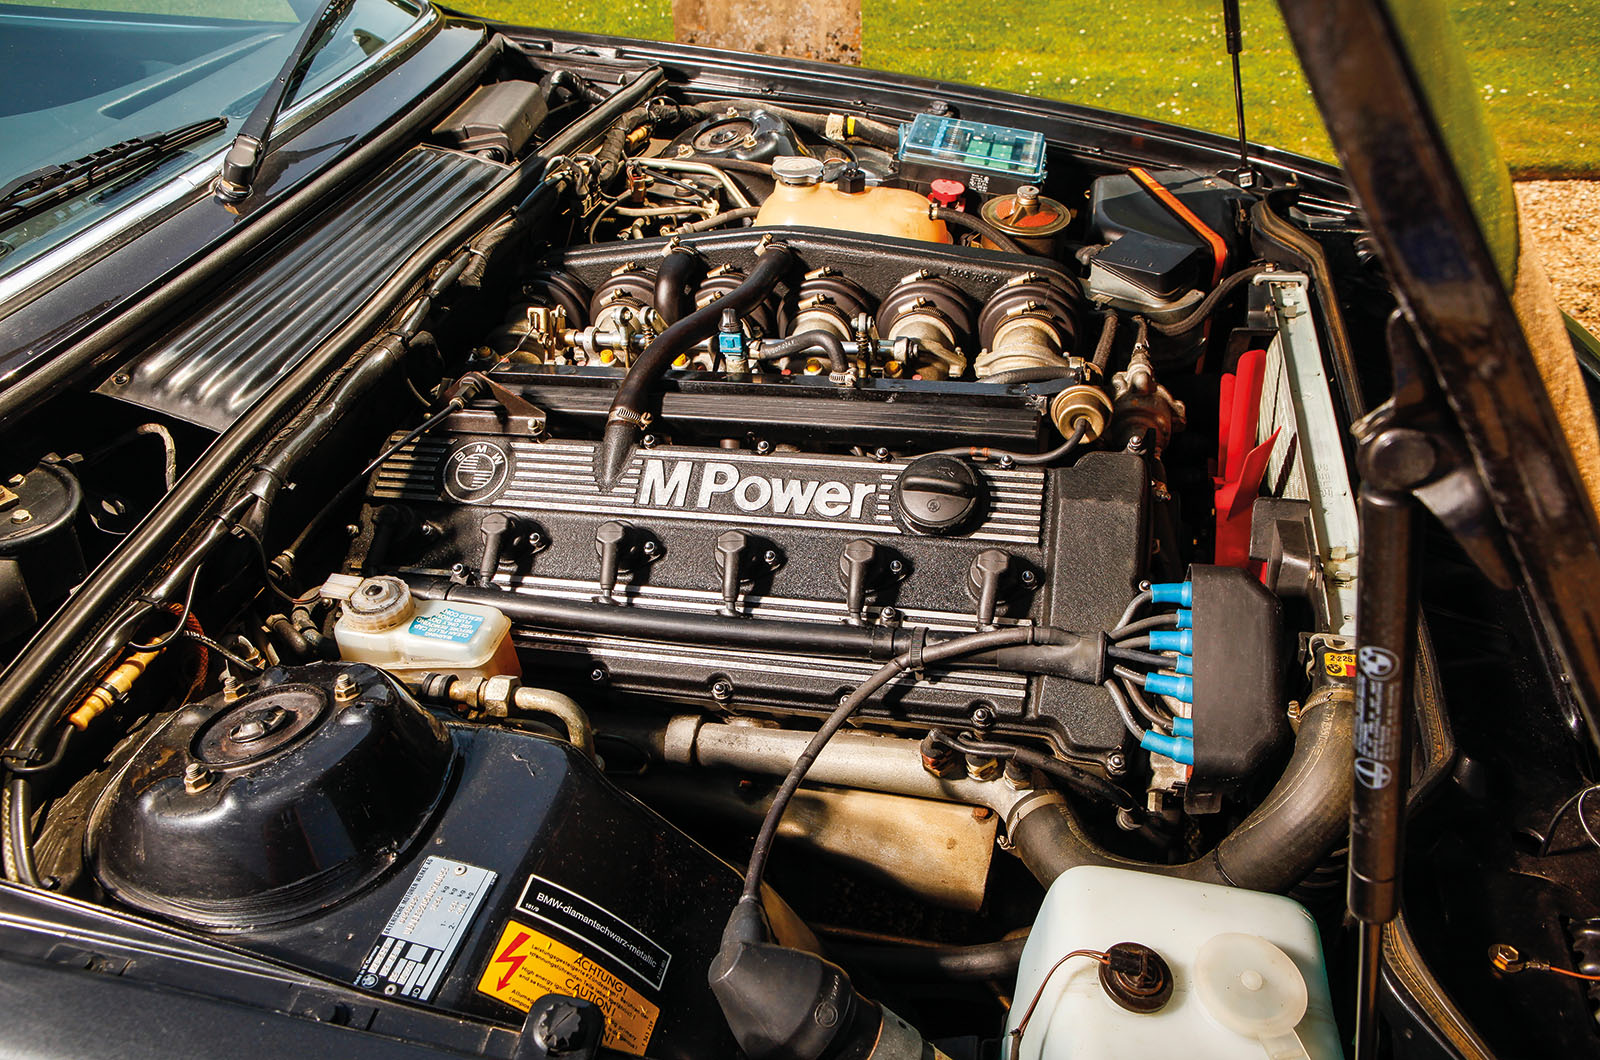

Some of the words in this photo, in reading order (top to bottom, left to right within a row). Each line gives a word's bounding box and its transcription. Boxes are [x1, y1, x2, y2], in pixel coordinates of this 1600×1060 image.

[638, 459, 694, 507] M
[697, 461, 877, 519] Power
[384, 906, 405, 934] BAYERISCHE
[402, 883, 419, 905] MOTOREN
[416, 867, 428, 882] WERKE
[536, 892, 657, 968] BMW-diamantschwarz-metallic
[521, 967, 534, 975] High
[535, 973, 553, 986] energy
[565, 978, 616, 1017] CAUTION!
[573, 956, 628, 996] ACHTUNG!
